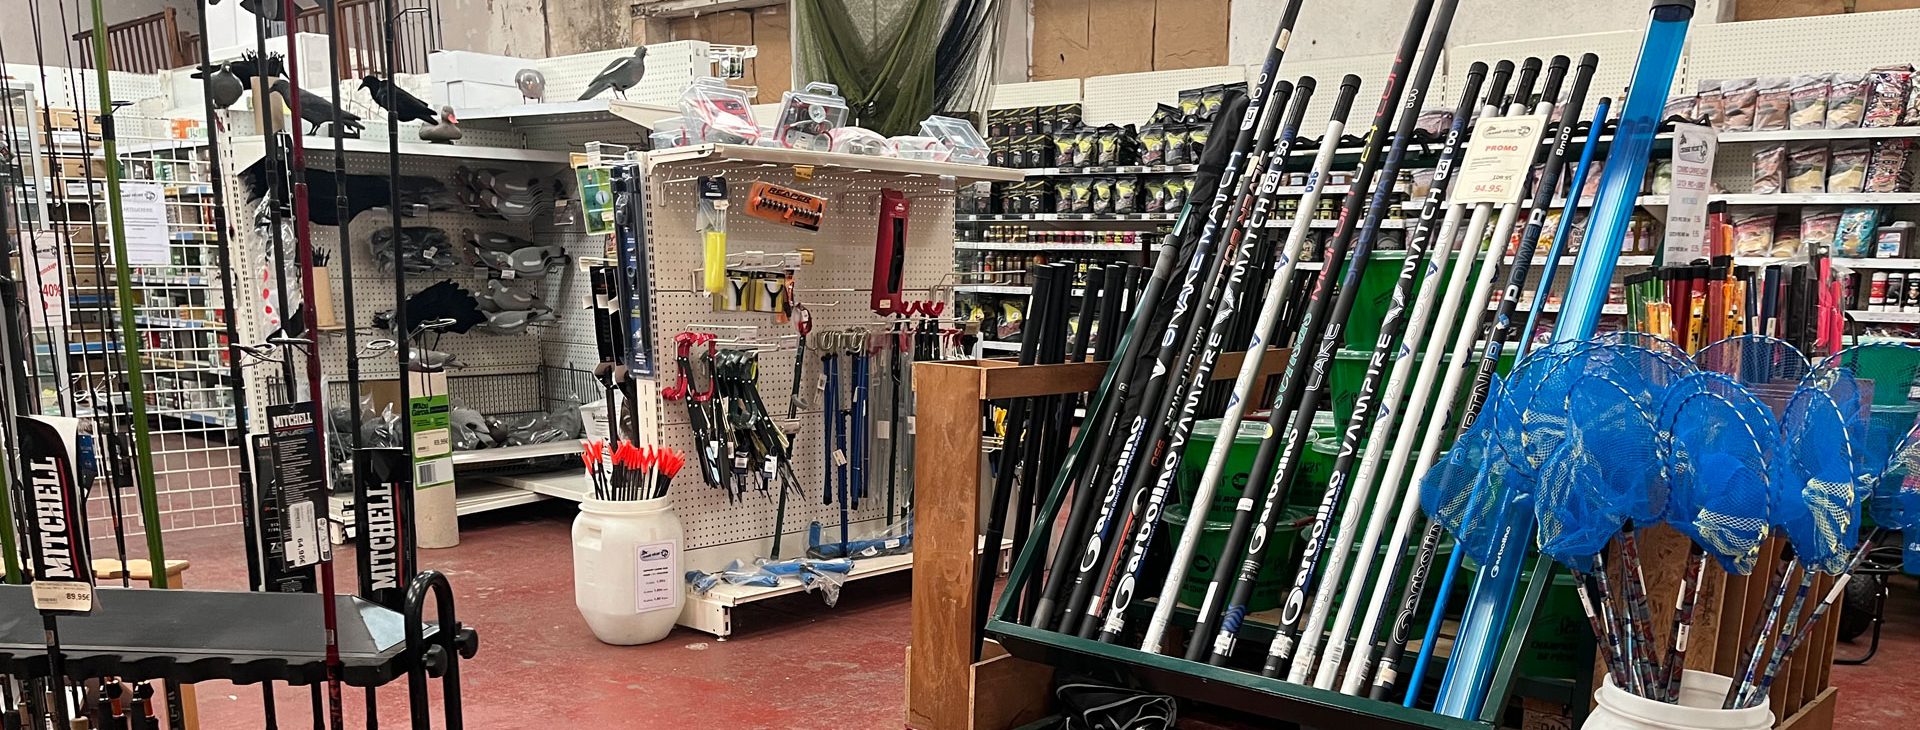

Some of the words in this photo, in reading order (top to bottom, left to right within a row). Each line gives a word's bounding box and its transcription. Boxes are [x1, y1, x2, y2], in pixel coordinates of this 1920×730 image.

[768, 187, 812, 205] REAPER
[1197, 148, 1243, 245] MATCH
[1170, 329, 1223, 451] VAMPIRE
[1229, 195, 1271, 284] MATCH
[1261, 167, 1281, 194] 321
[1502, 205, 1548, 304] POWER
[1303, 319, 1341, 394] LAKE
[1337, 330, 1390, 461] VAMPIRE
[1398, 185, 1442, 280] MATCH
[272, 411, 313, 429] MITCHELL
[1162, 373, 1190, 428] POWER
[30, 456, 75, 579] MITCHELL
[366, 482, 397, 591] MITCHELL
[1077, 413, 1150, 575] Garbolino
[1109, 448, 1182, 615] Garbolino
[1246, 426, 1304, 557] Garbolino
[1278, 468, 1348, 628] Garbolino
[1389, 517, 1445, 645] Garbolin
[1487, 523, 1514, 579] Garbolino
